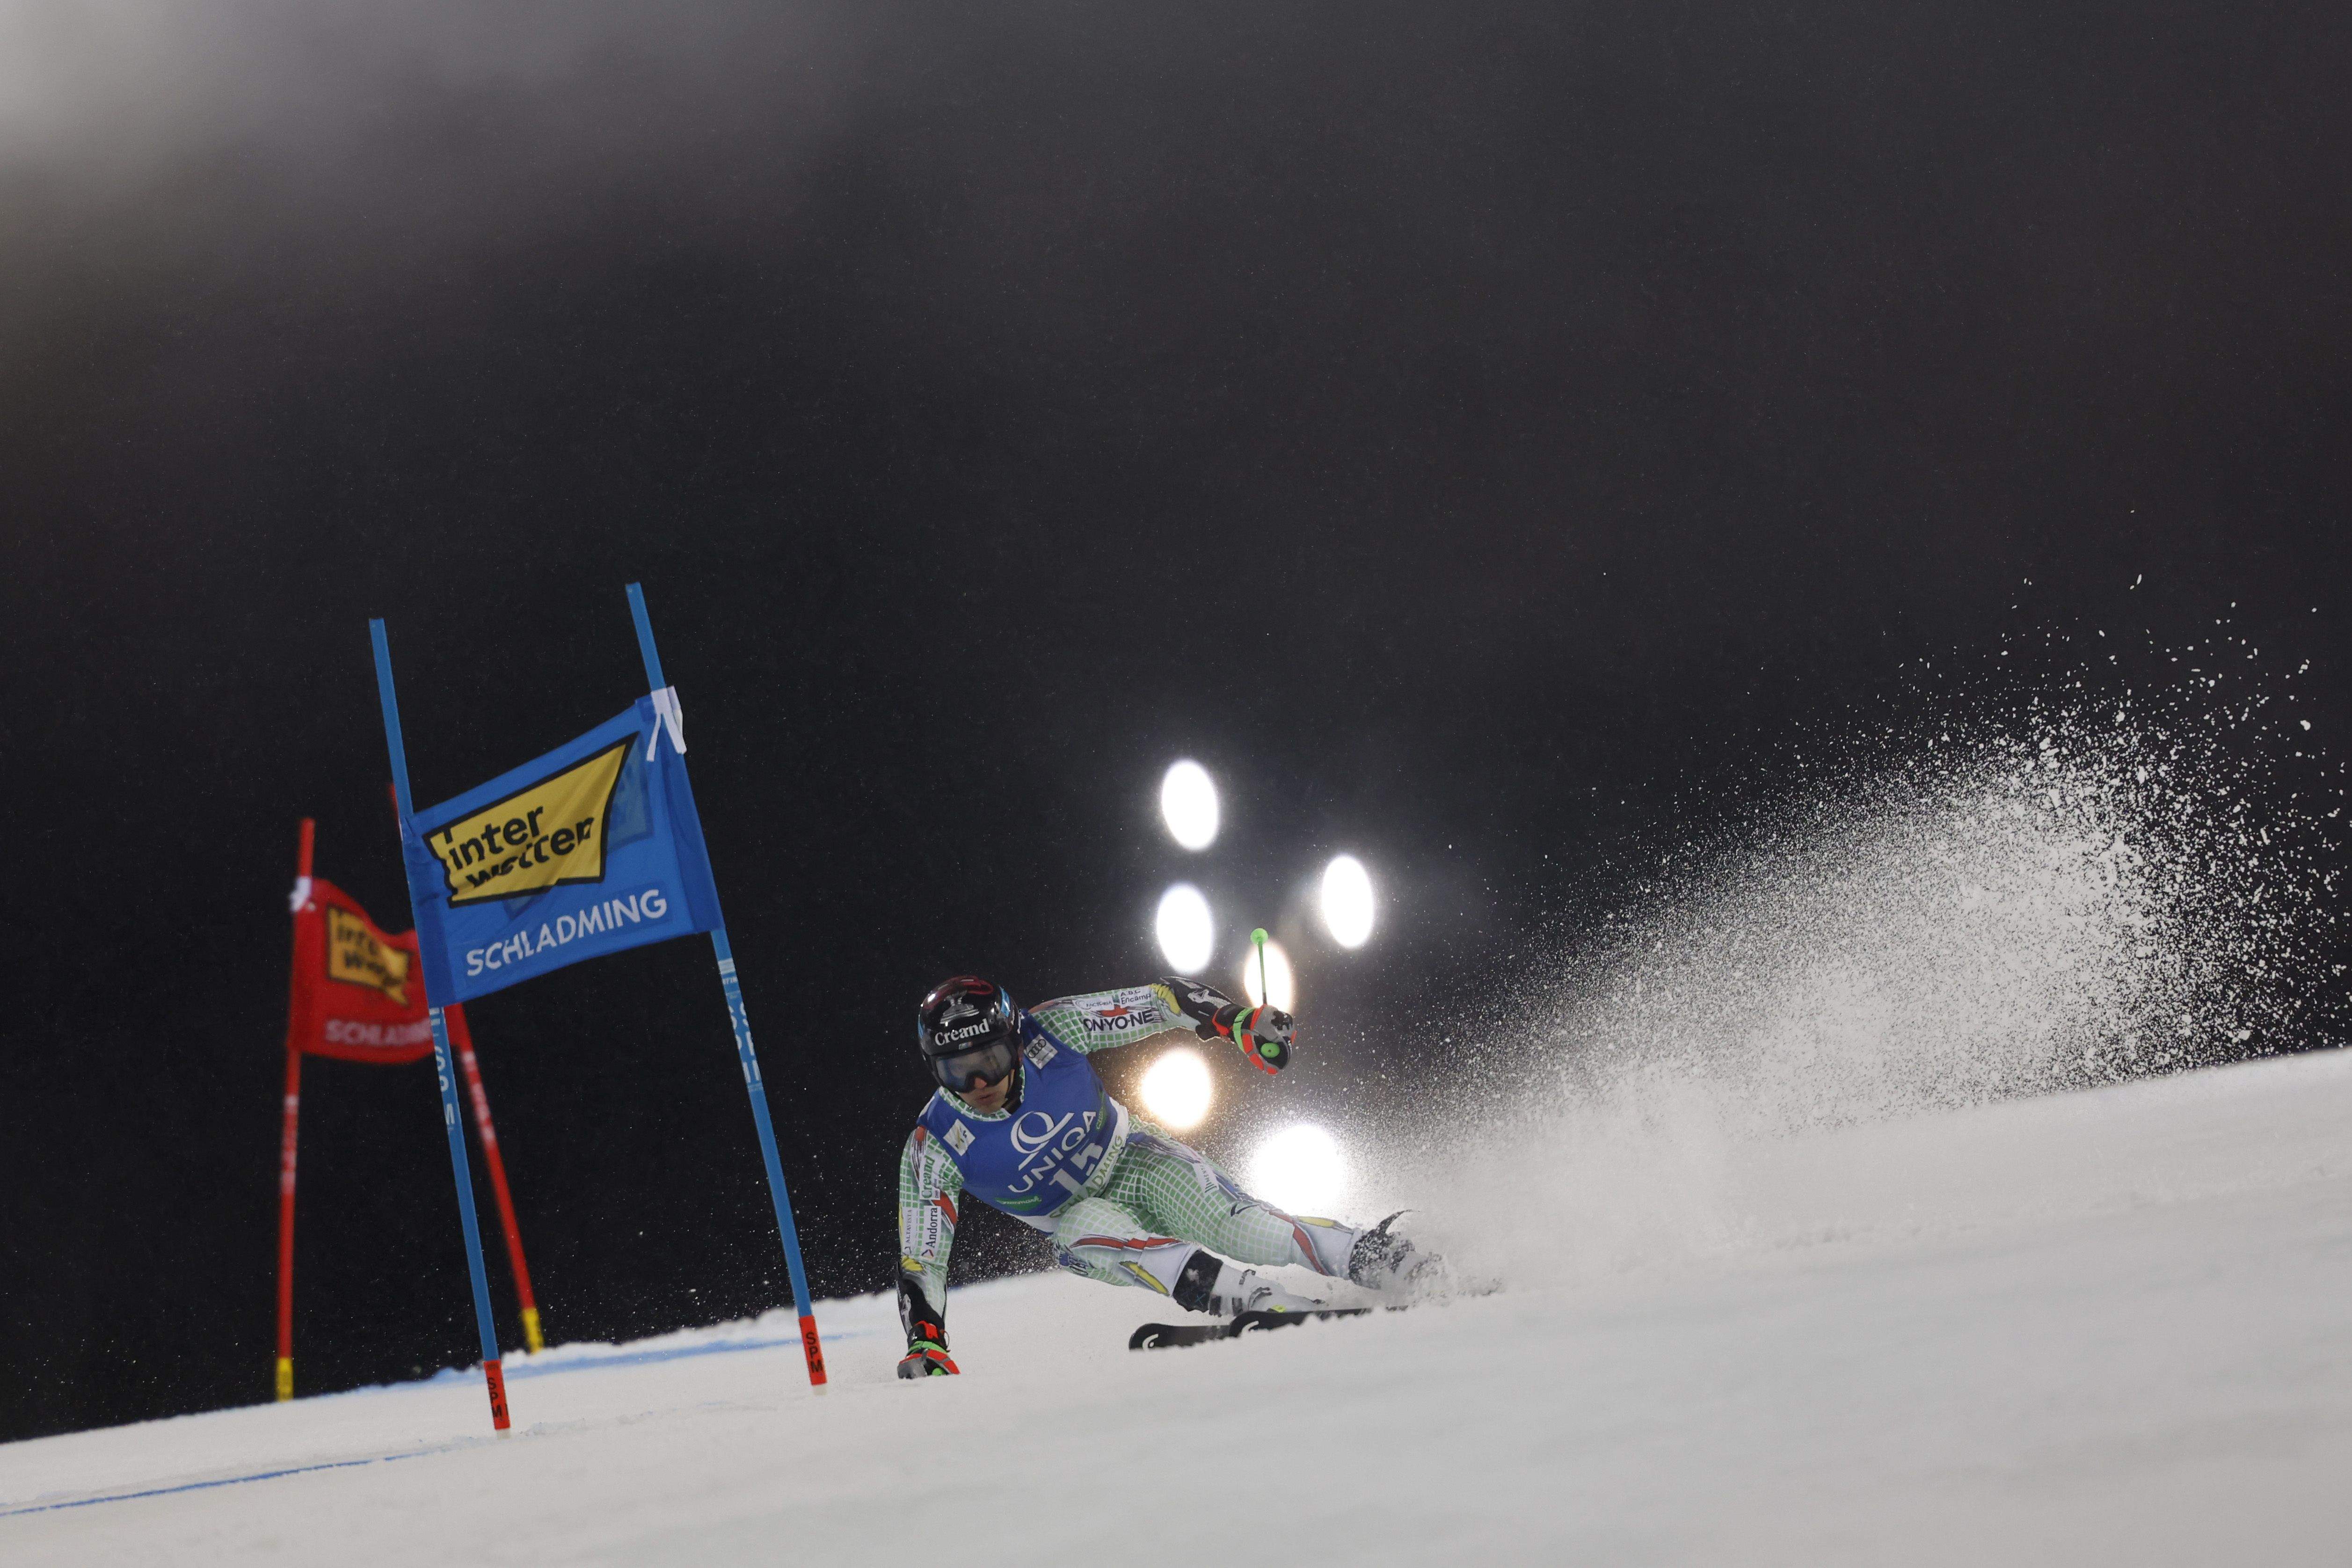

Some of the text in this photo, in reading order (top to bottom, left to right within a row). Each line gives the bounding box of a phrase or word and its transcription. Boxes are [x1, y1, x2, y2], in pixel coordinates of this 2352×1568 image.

[449, 805, 544, 870] inter
[466, 889, 668, 977] SCHLADMING
[1121, 992, 1151, 1005] Encamp
[935, 1018, 990, 1046] Creand
[1007, 1111, 1096, 1193] UNIQA
[921, 1154, 935, 1199] Creand
[925, 1207, 938, 1248] Andorra
[806, 1332, 823, 1373] SPM
